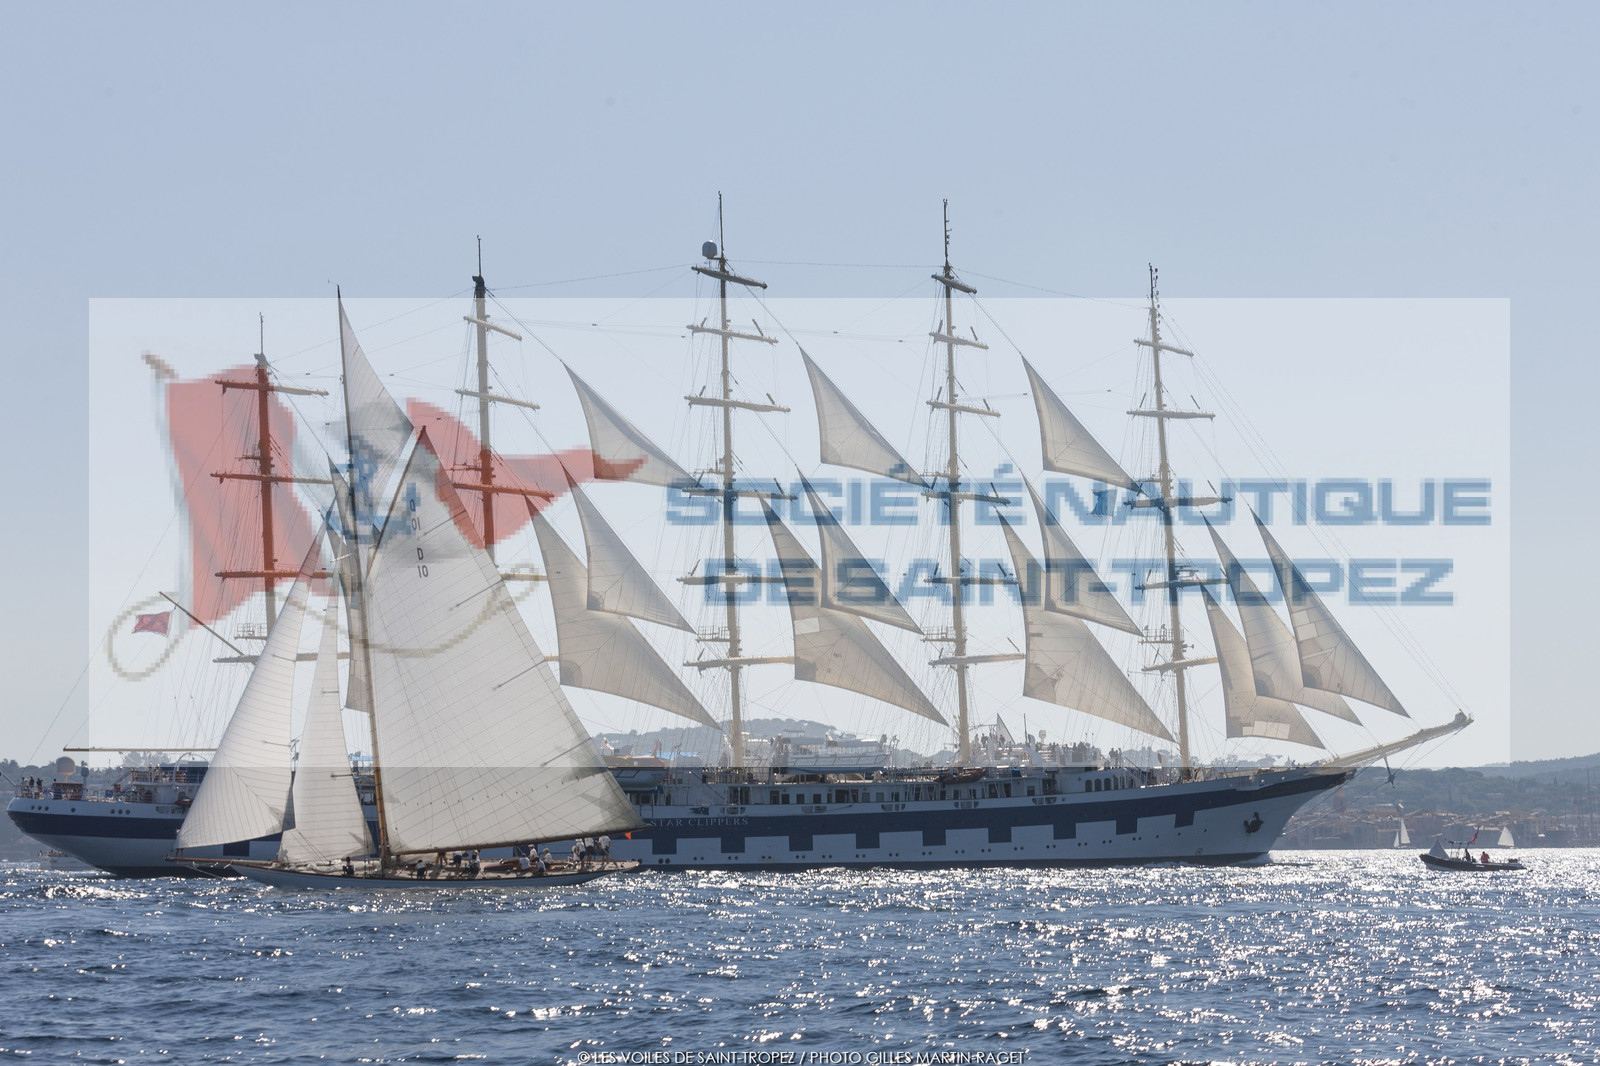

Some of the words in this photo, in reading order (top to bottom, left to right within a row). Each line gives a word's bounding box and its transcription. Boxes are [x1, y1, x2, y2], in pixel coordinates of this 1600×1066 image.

[416, 547, 424, 560] D
[417, 565, 429, 578] 10
[650, 818, 682, 827] STAR
[688, 817, 748, 826] CLIPPERS
